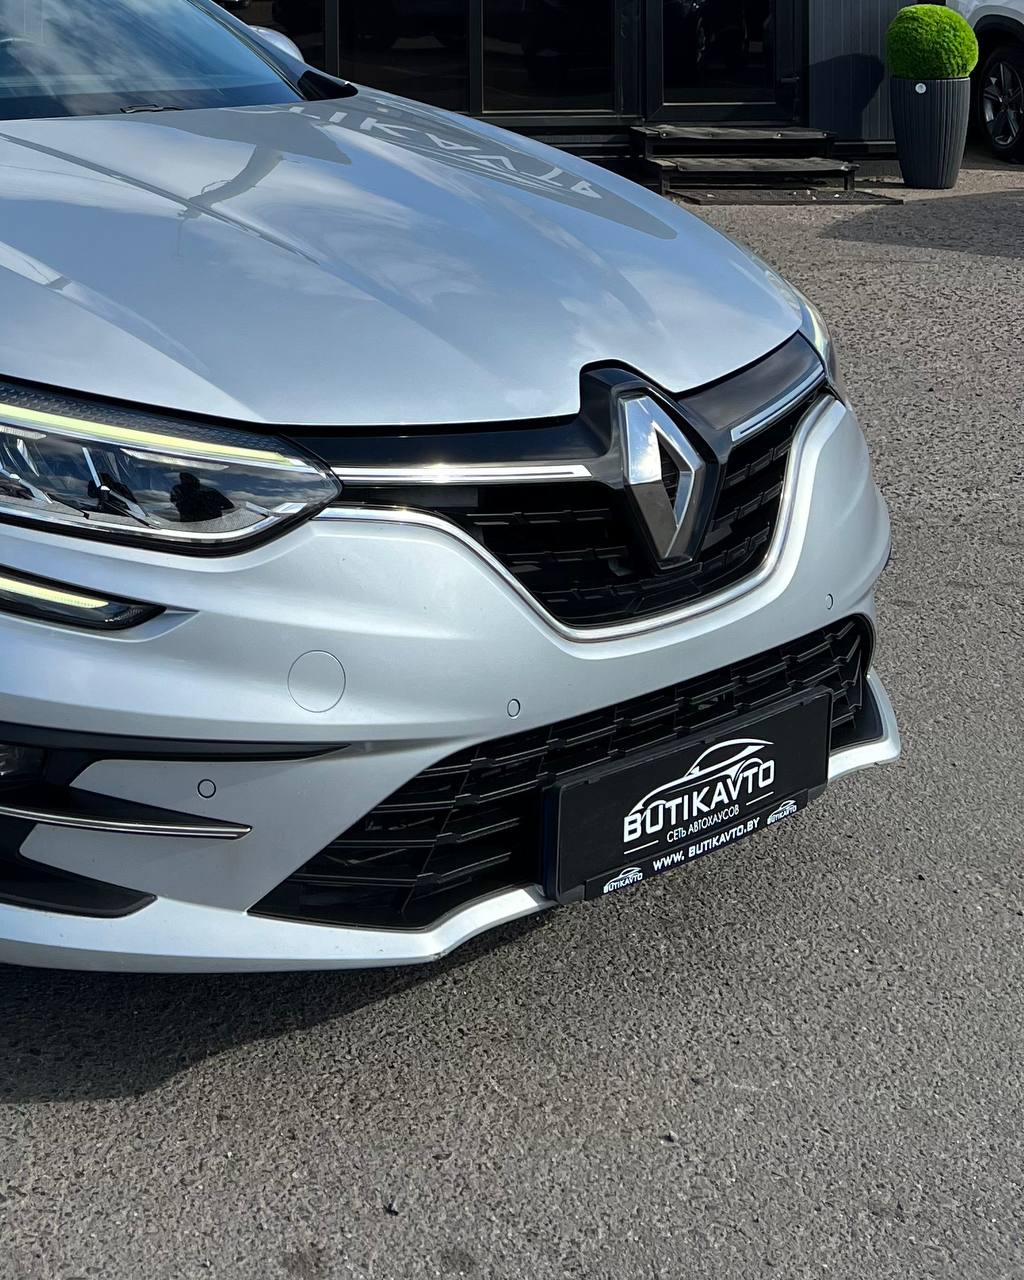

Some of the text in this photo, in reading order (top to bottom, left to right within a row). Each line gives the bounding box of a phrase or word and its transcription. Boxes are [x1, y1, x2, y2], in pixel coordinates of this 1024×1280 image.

[623, 759, 775, 843] BUTIKAVTO
[666, 804, 740, 843] СЕТЬ АВТОХАУСОВ
[653, 816, 760, 872] WWW. BUTIKAVTO.BY
[603, 872, 643, 894] BUTIKAVTO
